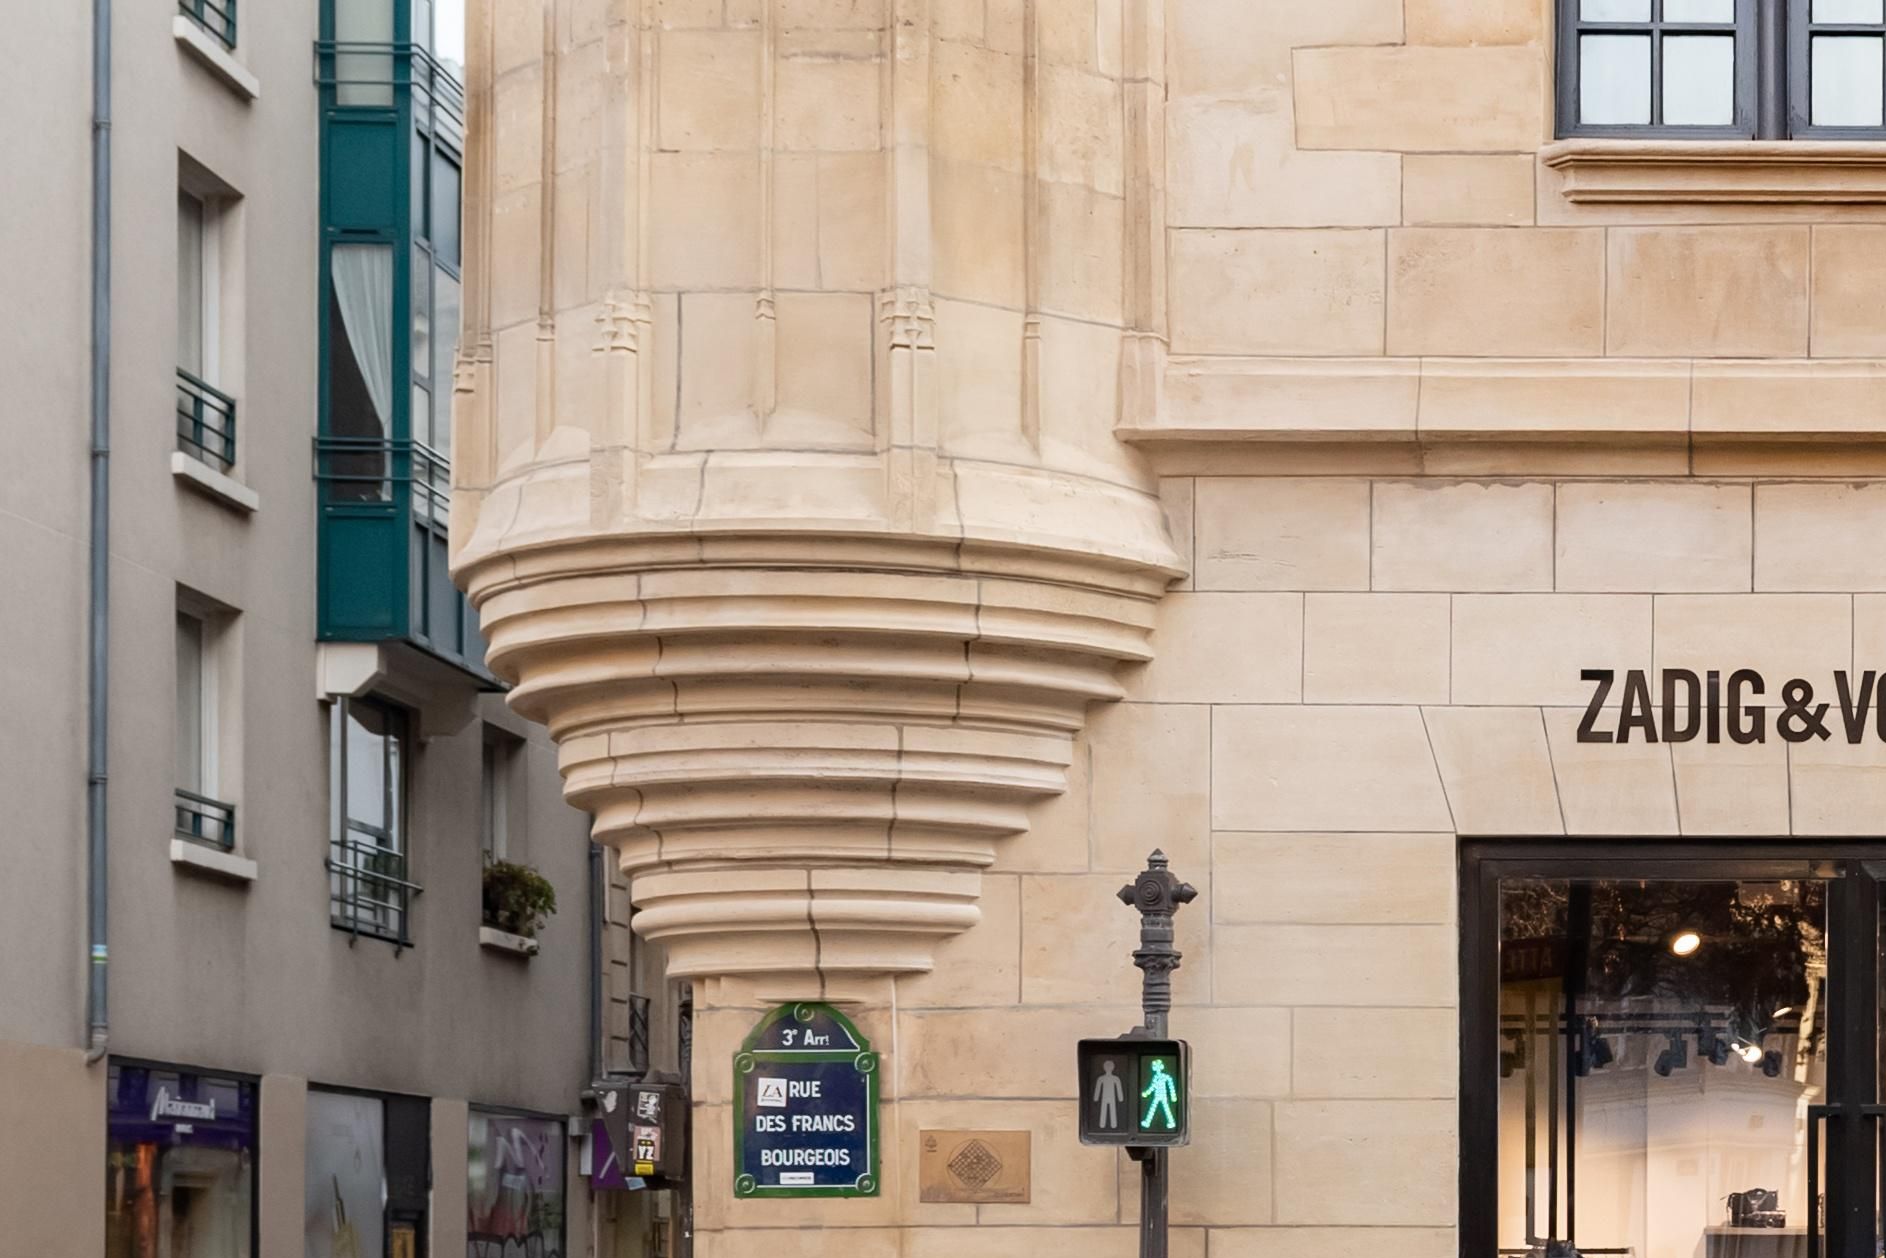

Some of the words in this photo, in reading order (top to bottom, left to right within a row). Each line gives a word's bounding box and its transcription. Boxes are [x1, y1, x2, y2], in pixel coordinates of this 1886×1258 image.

[788, 1080, 822, 1098] RUE
[755, 1114, 787, 1132] DES
[791, 1114, 856, 1132] FRANCS
[760, 1148, 851, 1167] BOURGEOIS
